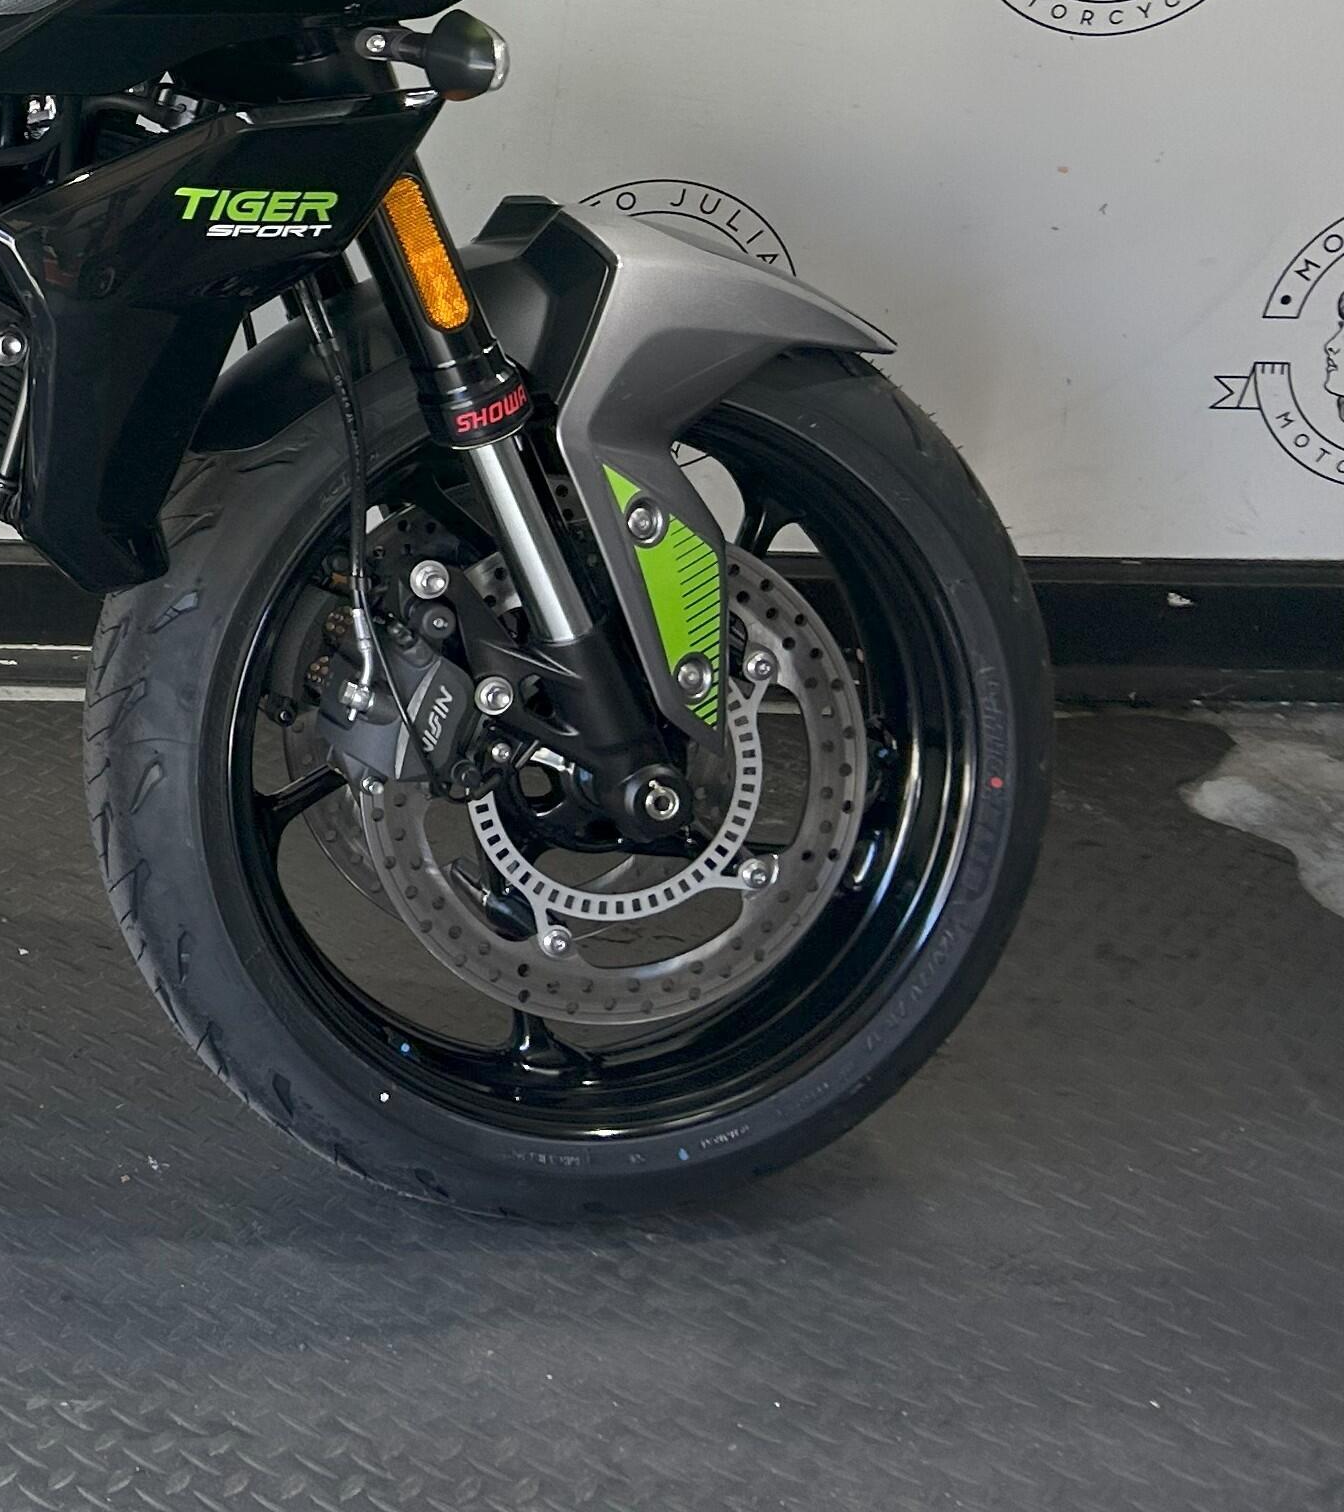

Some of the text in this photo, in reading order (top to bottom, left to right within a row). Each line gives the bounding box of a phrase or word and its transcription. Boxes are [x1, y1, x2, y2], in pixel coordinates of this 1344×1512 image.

[174, 187, 339, 222] TIGER
[206, 224, 332, 238] SPORT
[455, 383, 528, 433] SHOWA
